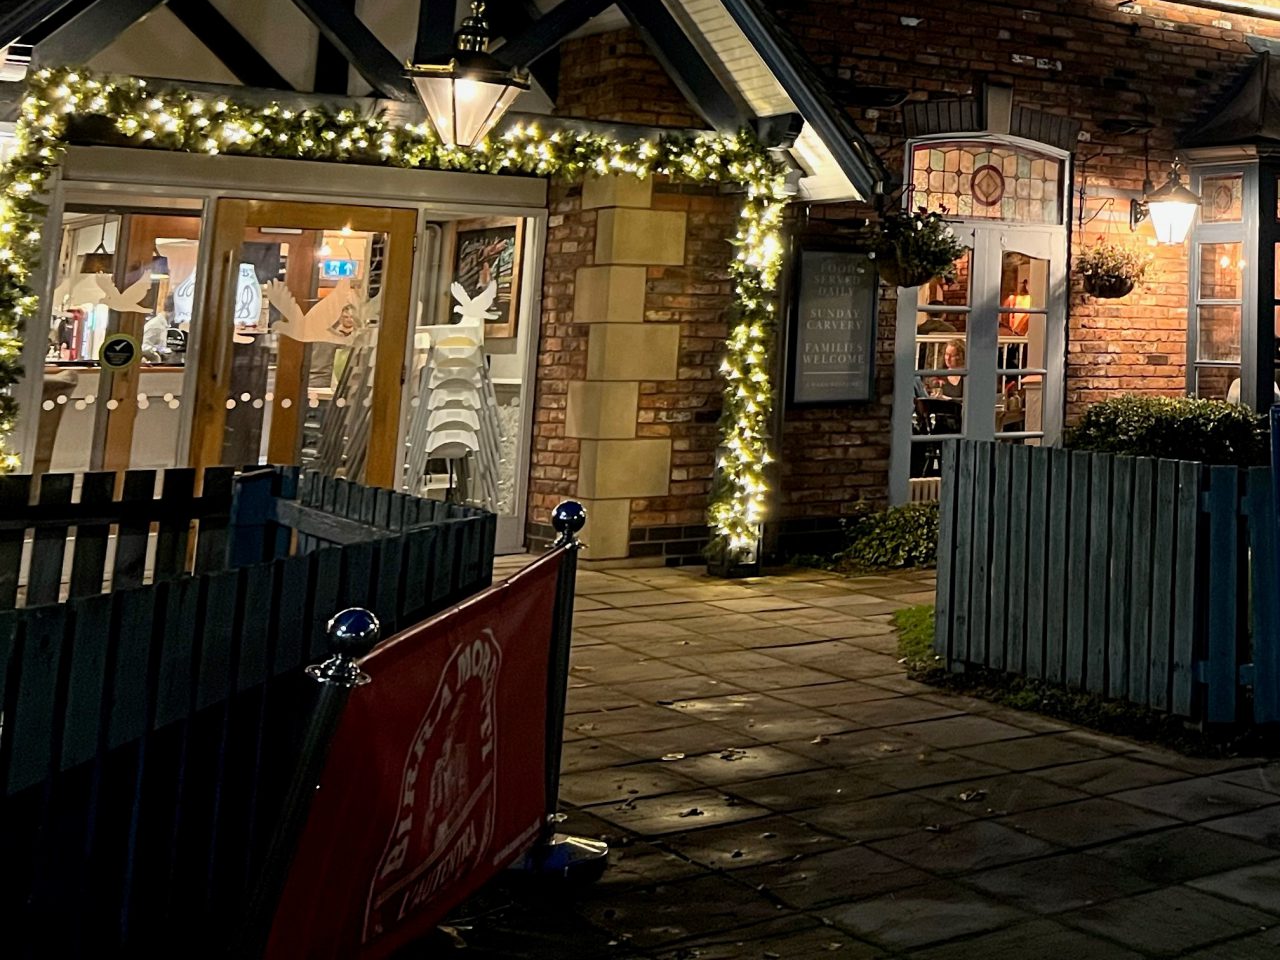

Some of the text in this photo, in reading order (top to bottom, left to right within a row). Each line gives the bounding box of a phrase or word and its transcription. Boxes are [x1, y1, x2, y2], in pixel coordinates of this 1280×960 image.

[810, 308, 861, 319] SUNDAY
[806, 319, 863, 330] CARVERY
[804, 342, 864, 353] FAMILIES
[803, 354, 865, 365] WELCOME
